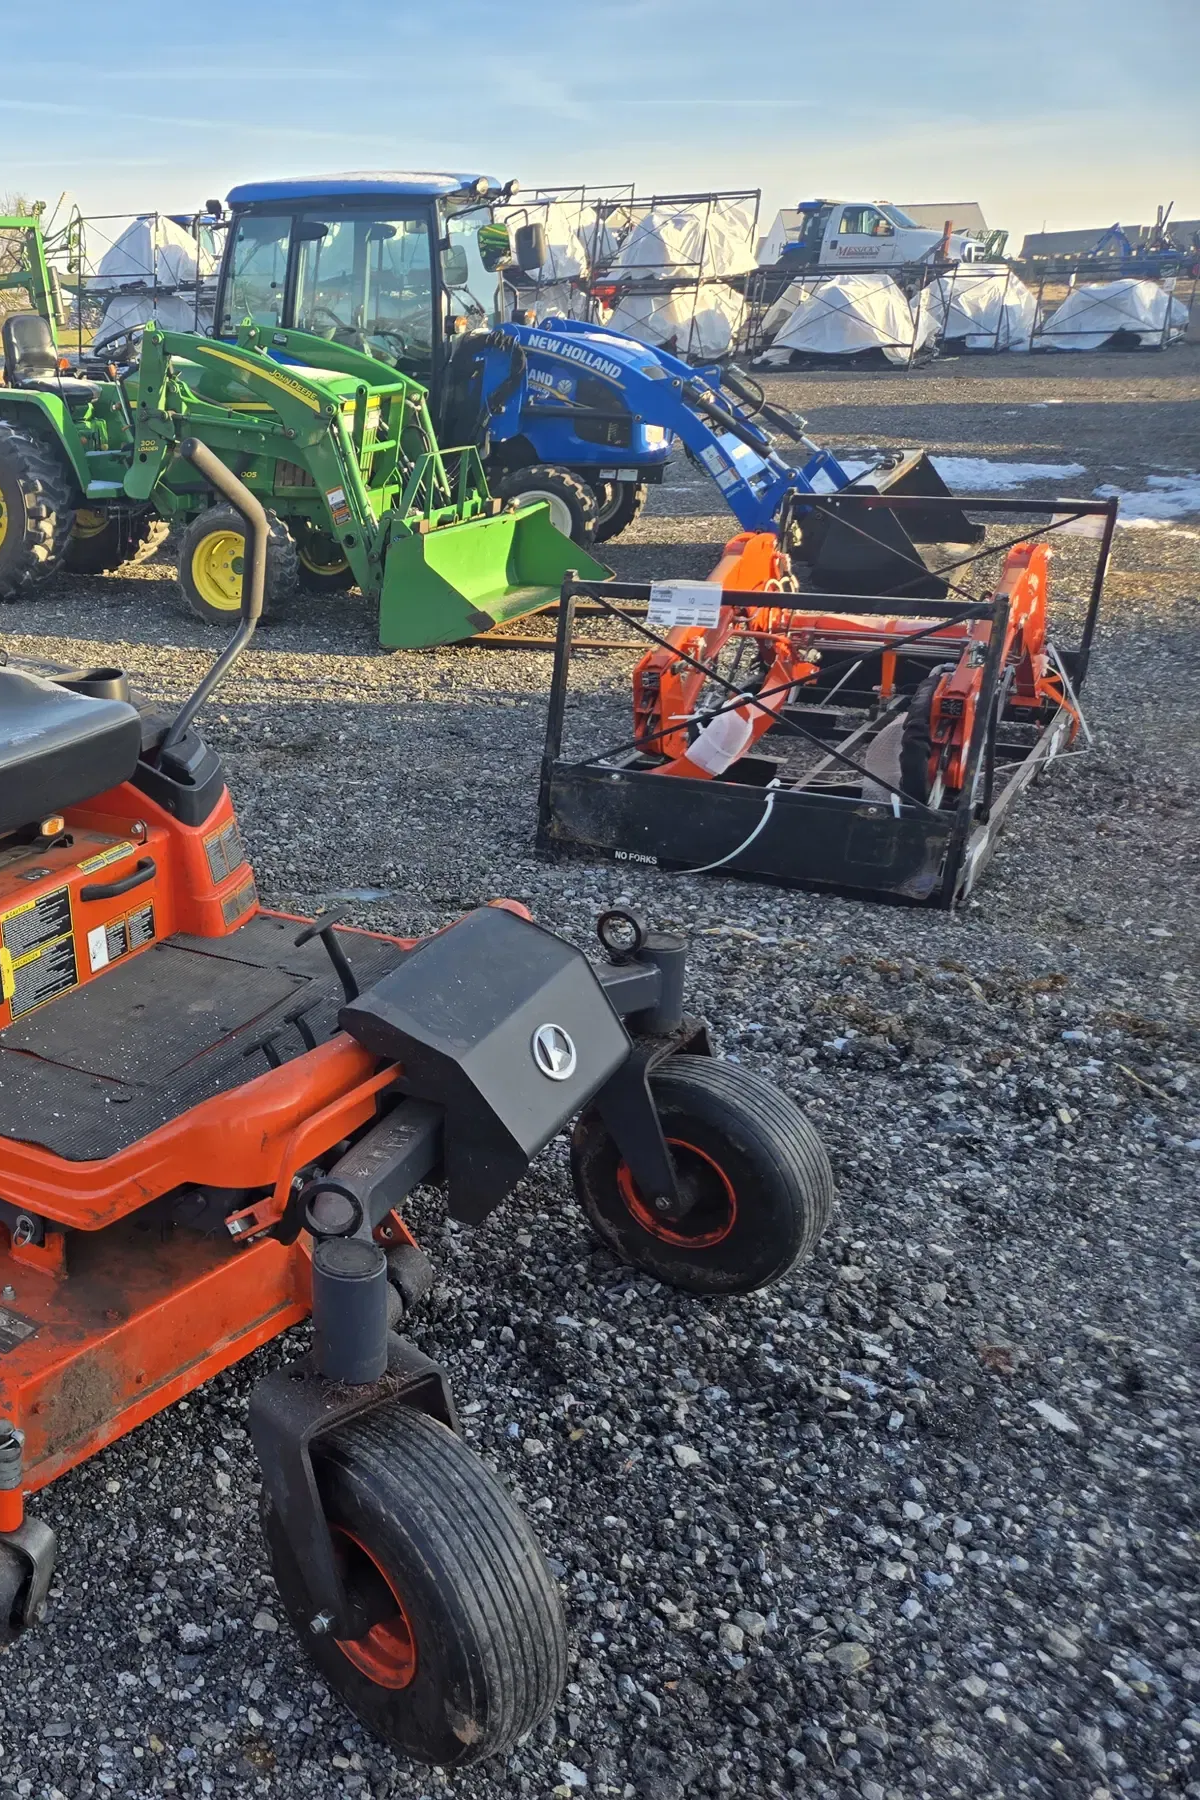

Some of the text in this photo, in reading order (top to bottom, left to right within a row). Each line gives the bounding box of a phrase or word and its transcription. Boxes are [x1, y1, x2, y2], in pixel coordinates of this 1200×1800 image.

[528, 334, 622, 379] NEW HOLLAND
[269, 369, 318, 401] JOHN DEERE
[614, 850, 658, 865] NO FORKS
[9, 904, 29, 917] CAUTION
